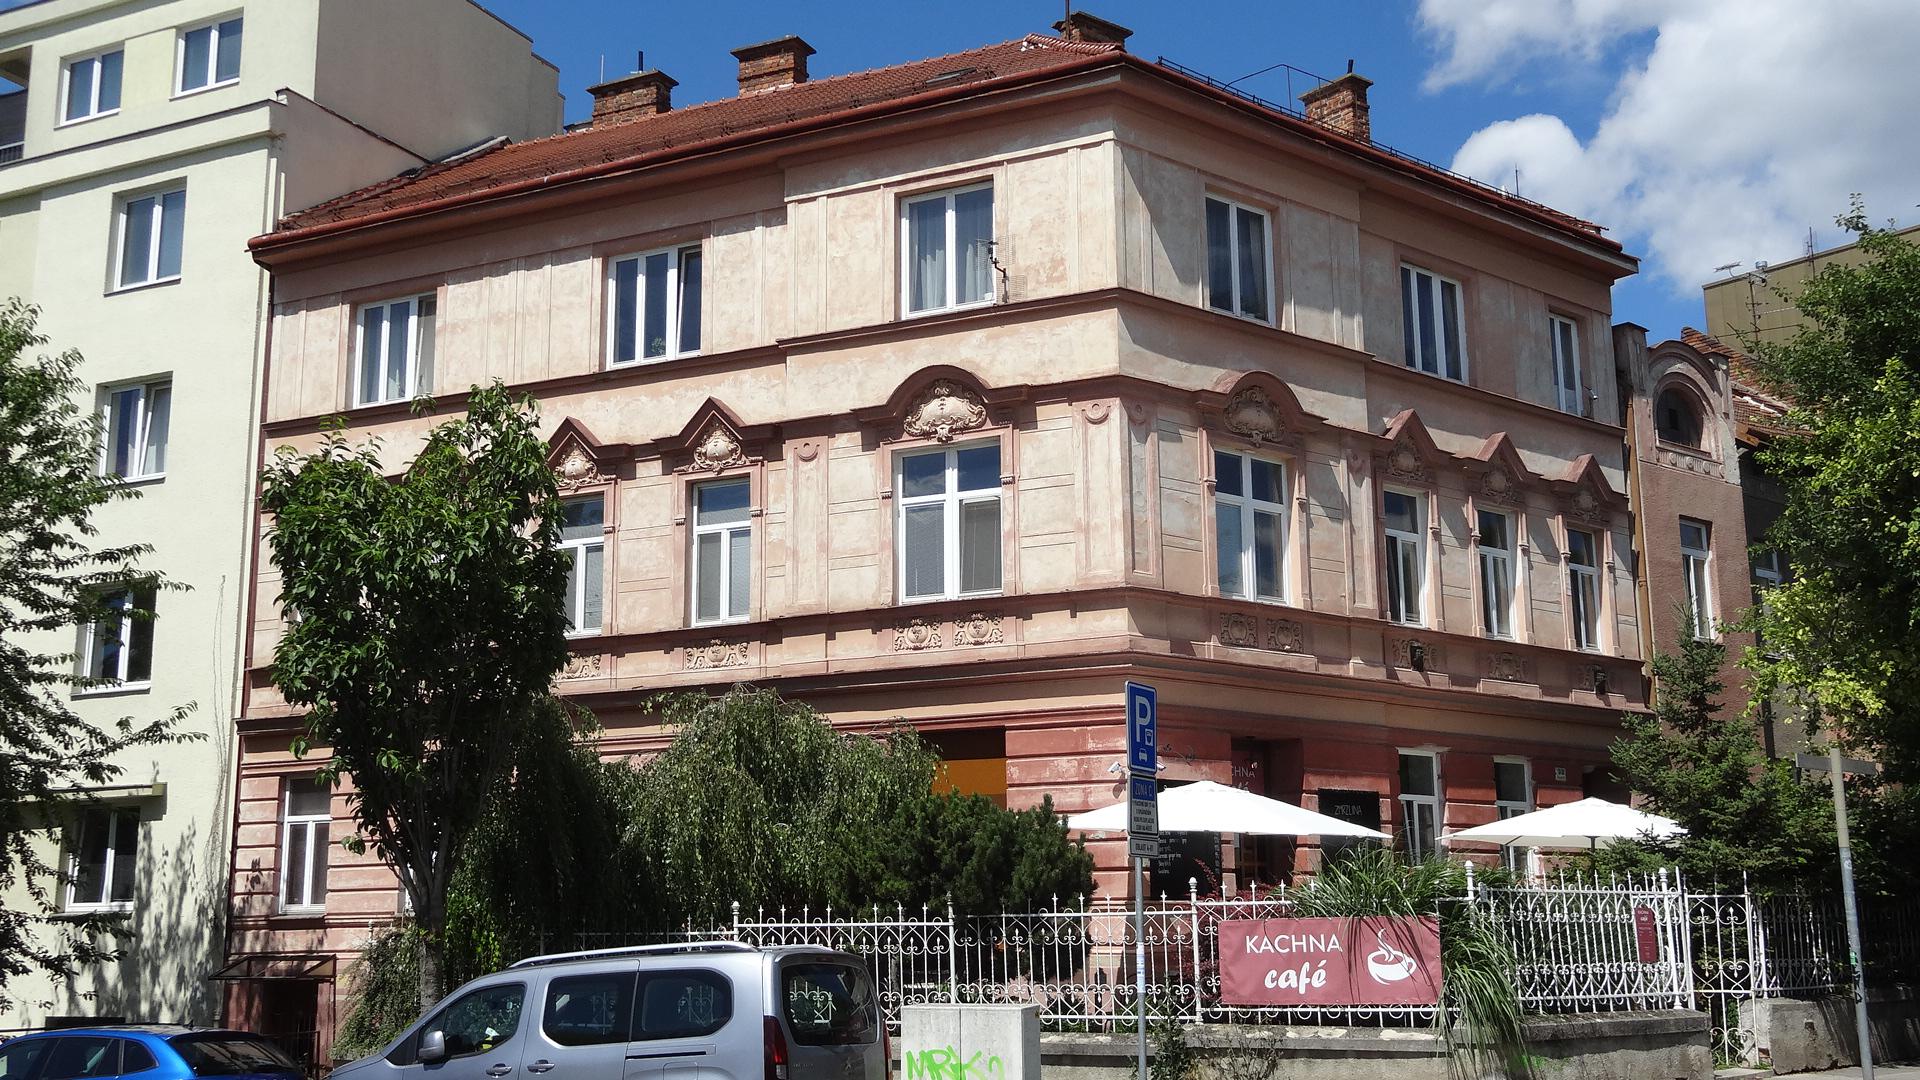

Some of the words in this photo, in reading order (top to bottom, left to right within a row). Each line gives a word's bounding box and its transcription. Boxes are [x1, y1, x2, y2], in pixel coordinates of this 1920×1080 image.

[1135, 694, 1151, 743] P
[1232, 765, 1256, 778] HNA
[1246, 934, 1343, 954] KACHNA
[1264, 959, 1327, 994] café
